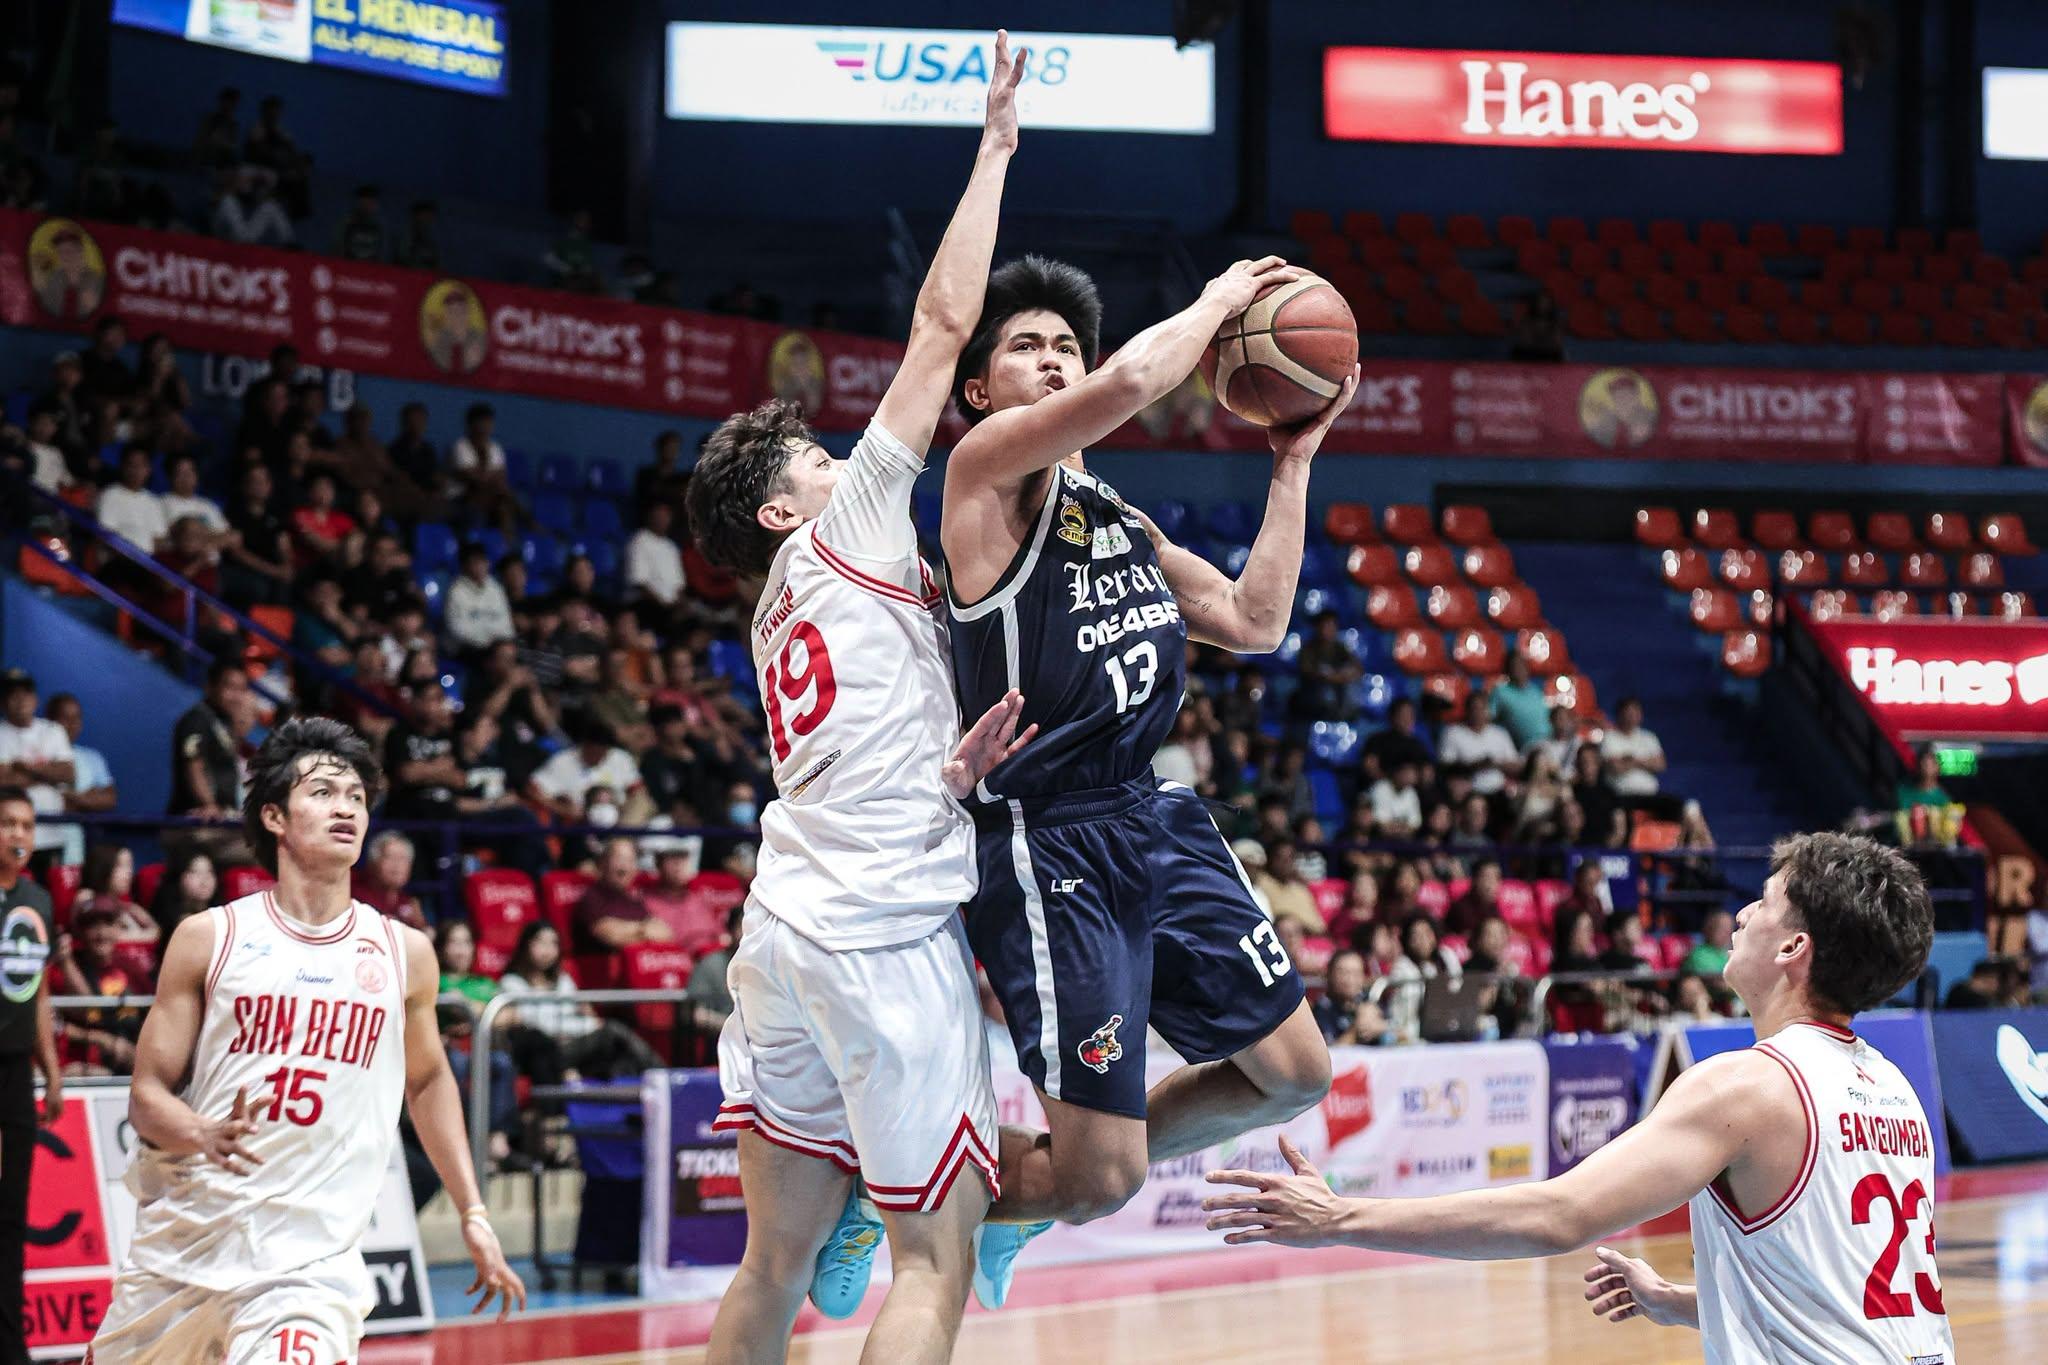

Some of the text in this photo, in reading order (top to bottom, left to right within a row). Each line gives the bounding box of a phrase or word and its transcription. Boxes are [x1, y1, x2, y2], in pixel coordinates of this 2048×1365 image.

[1461, 60, 1700, 142] Hanes
[765, 620, 837, 763] 19
[1104, 640, 1159, 714] 13
[1847, 647, 2014, 706] Hanes
[1239, 919, 1292, 987] 13
[229, 994, 387, 1070] SAN BEDA
[265, 1065, 328, 1127] 15
[1851, 1173, 1946, 1320] 23
[272, 1327, 319, 1365] 15
